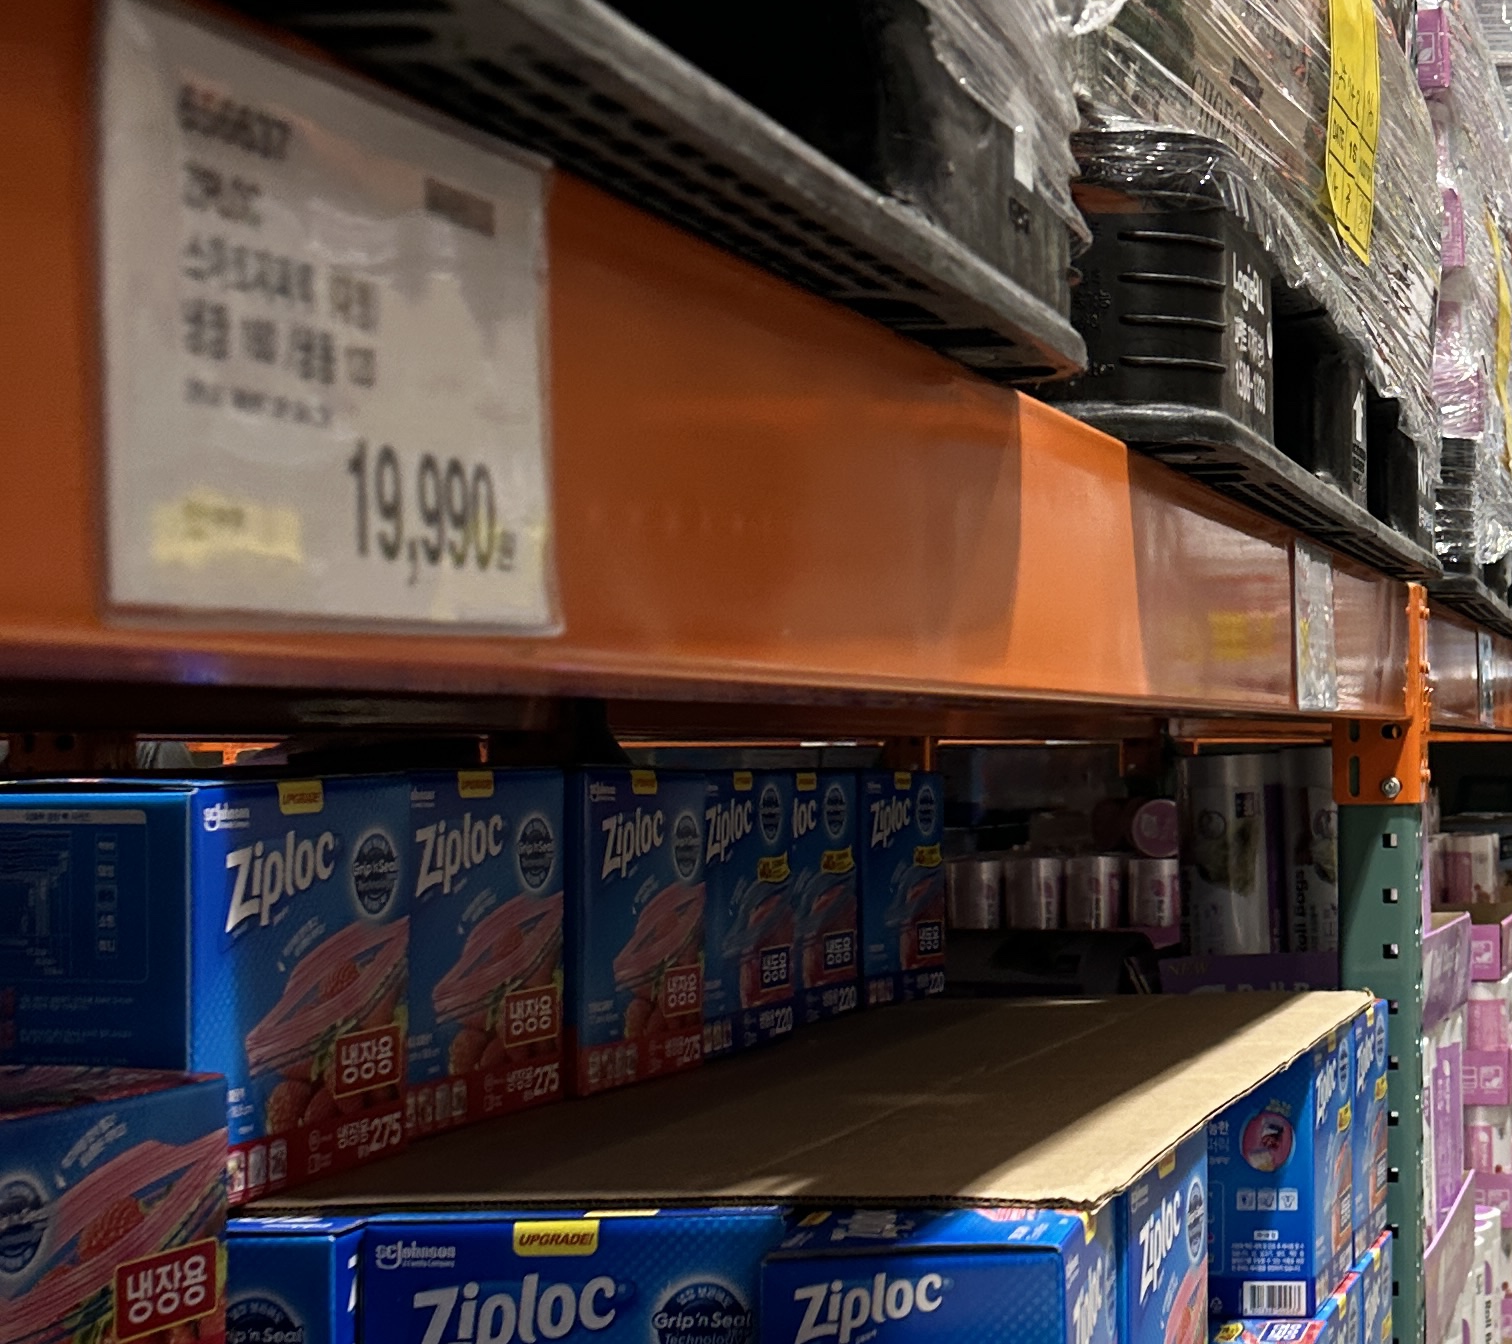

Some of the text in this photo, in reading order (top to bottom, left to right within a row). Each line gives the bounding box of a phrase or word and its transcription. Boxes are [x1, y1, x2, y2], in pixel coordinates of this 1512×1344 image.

[347, 439, 497, 586] 19,990
[601, 807, 664, 880] Ziploc
[705, 798, 753, 864] Ziploc
[869, 795, 911, 848] Ziploc
[415, 812, 503, 898] Ziploc
[224, 830, 335, 934] Ziploc
[508, 994, 553, 1036] 냉장용
[666, 973, 698, 1009] 냉장용
[341, 1035, 394, 1085] 냉장용
[533, 1063, 560, 1098] 275
[369, 1112, 402, 1152] 275
[518, 1232, 594, 1247] UPGRADE!
[1138, 1190, 1182, 1307] Ziploc
[127, 1256, 207, 1326] 냉장용
[653, 1311, 752, 1333] Grip'n Seal
